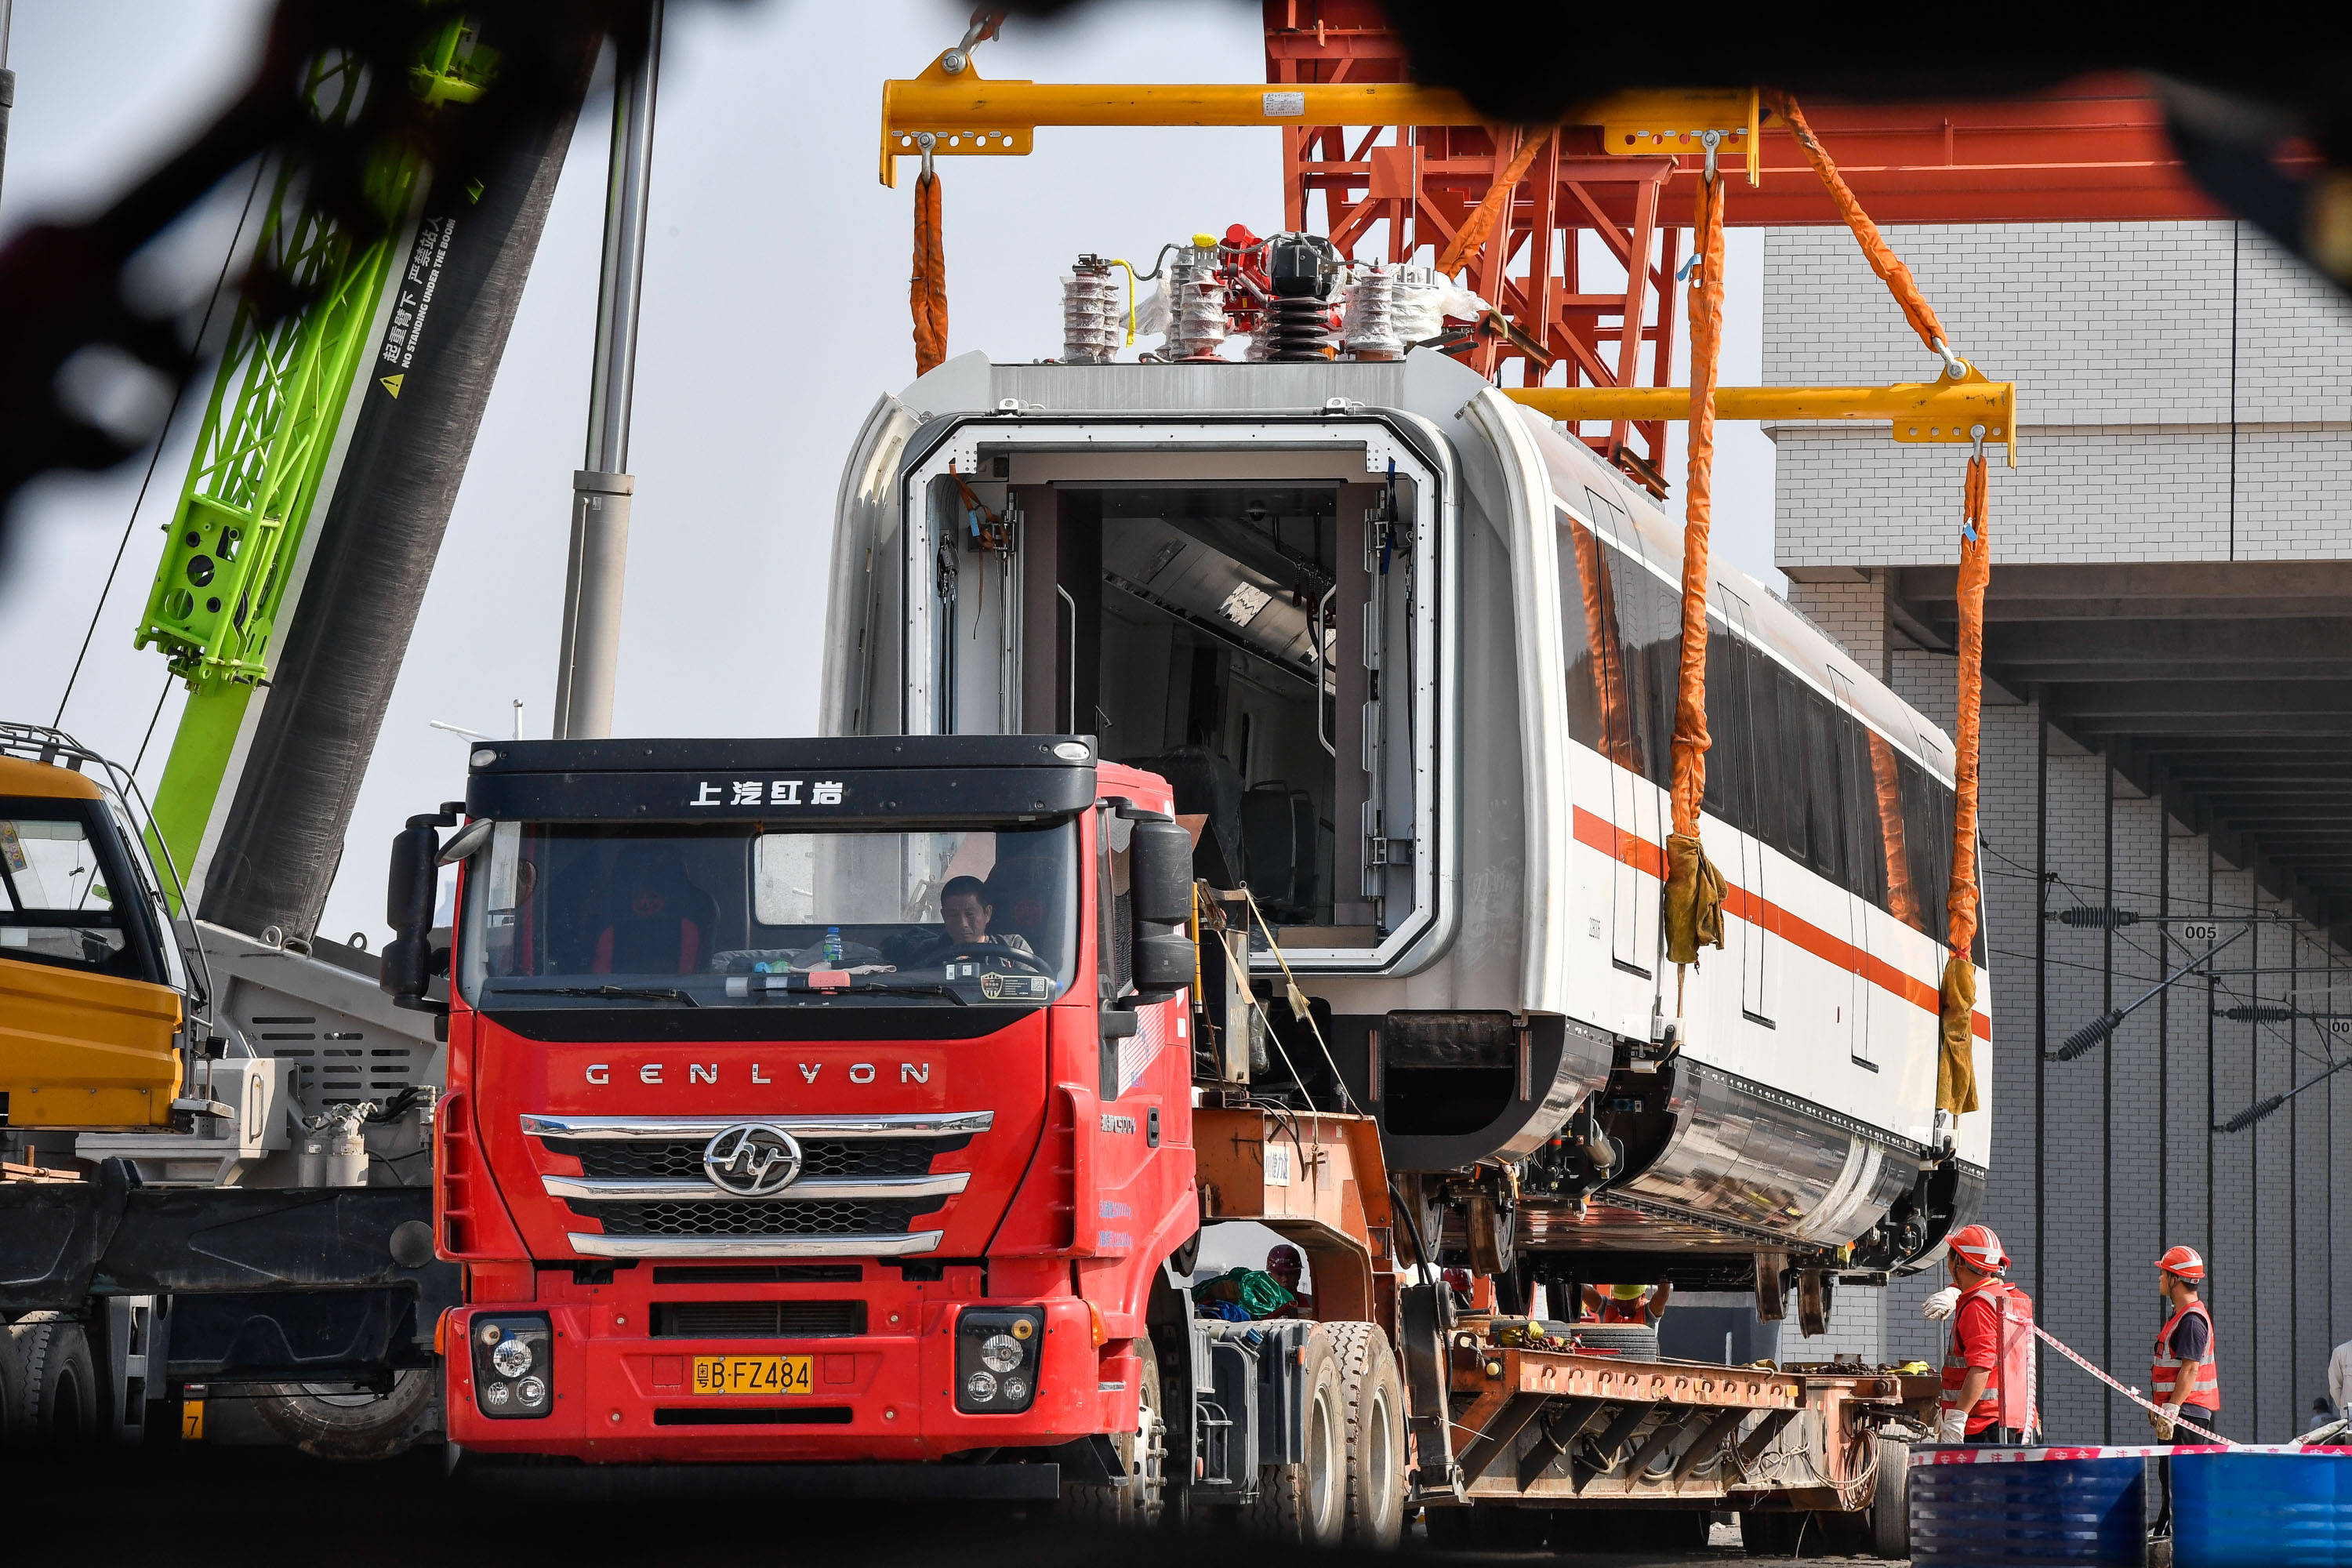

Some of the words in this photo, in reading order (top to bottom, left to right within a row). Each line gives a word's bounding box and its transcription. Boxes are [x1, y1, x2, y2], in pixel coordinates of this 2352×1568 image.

[383, 291, 416, 364] 起重臂下
[408, 216, 444, 285] 严禁站人
[401, 353, 412, 368] NO
[407, 303, 429, 353] STANDING
[422, 270, 439, 304] UNDER
[434, 249, 446, 270] THE
[690, 781, 844, 806] 上汽红岩
[2185, 926, 2217, 939] 005
[585, 1062, 929, 1085] GENLYON
[1940, 1453, 1968, 1464] 安全
[1991, 1450, 2027, 1463] 注意
[2054, 1450, 2089, 1460] 安全
